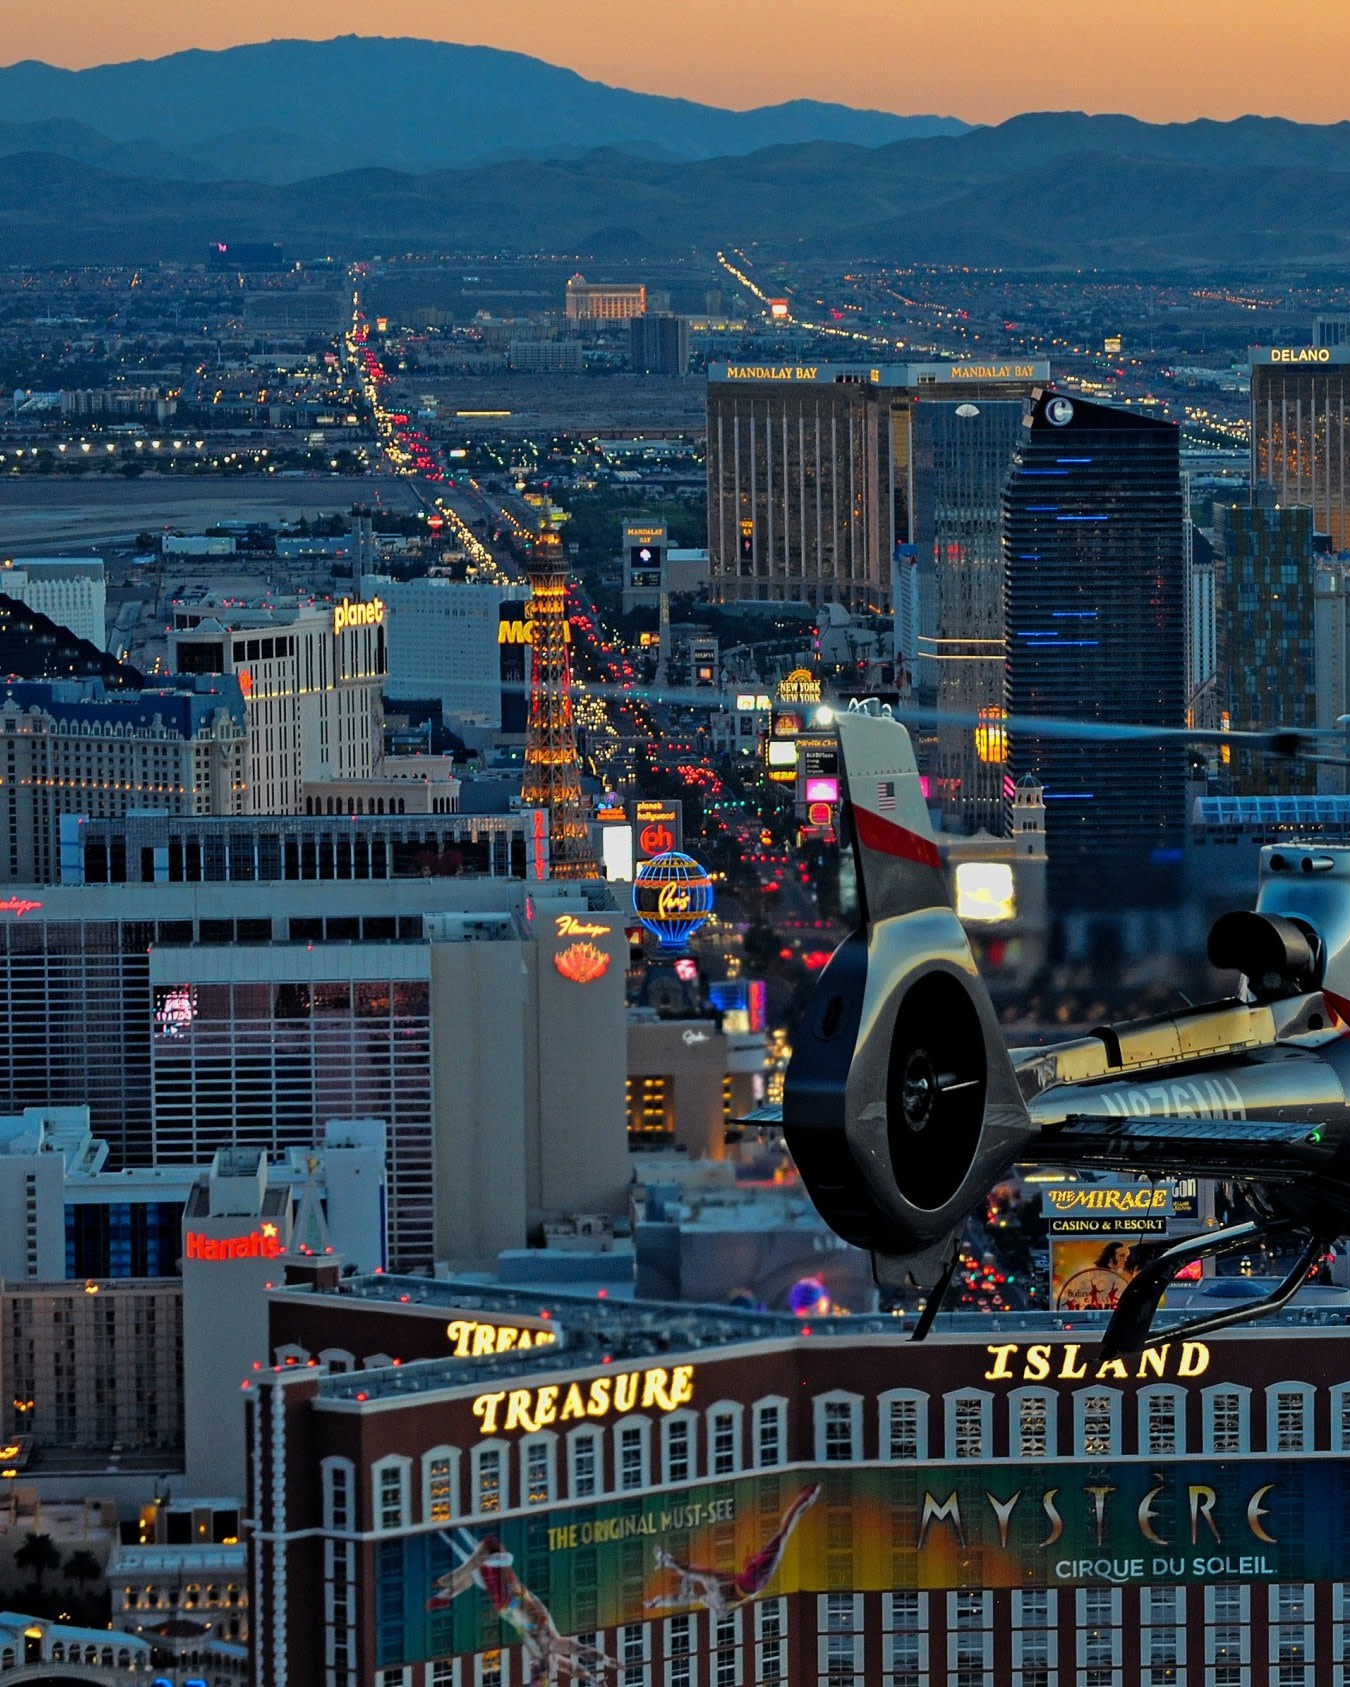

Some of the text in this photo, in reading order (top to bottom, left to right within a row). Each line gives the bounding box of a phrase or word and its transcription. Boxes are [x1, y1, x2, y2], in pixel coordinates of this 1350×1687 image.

[1271, 349, 1330, 362] DELANO
[727, 366, 817, 383] MANDALAY BAY
[951, 365, 1034, 382] MANDALAY BAY
[334, 597, 384, 635] planet
[779, 682, 821, 692] NEW YORK
[780, 693, 821, 703] NEW YORK
[1048, 1189, 1076, 1206] THE
[1057, 1189, 1168, 1211] MIRAGE
[1052, 1218, 1165, 1232] CASINO & RESORT
[985, 1342, 1210, 1380] ISLAND
[473, 1365, 694, 1434] TREASURE
[917, 1473, 1278, 1550] MYSTÈRE
[548, 1498, 734, 1551] THE ORIGINAL MUST-SEE
[1056, 1556, 1273, 1583] CIRQUE DU SOLEIL
